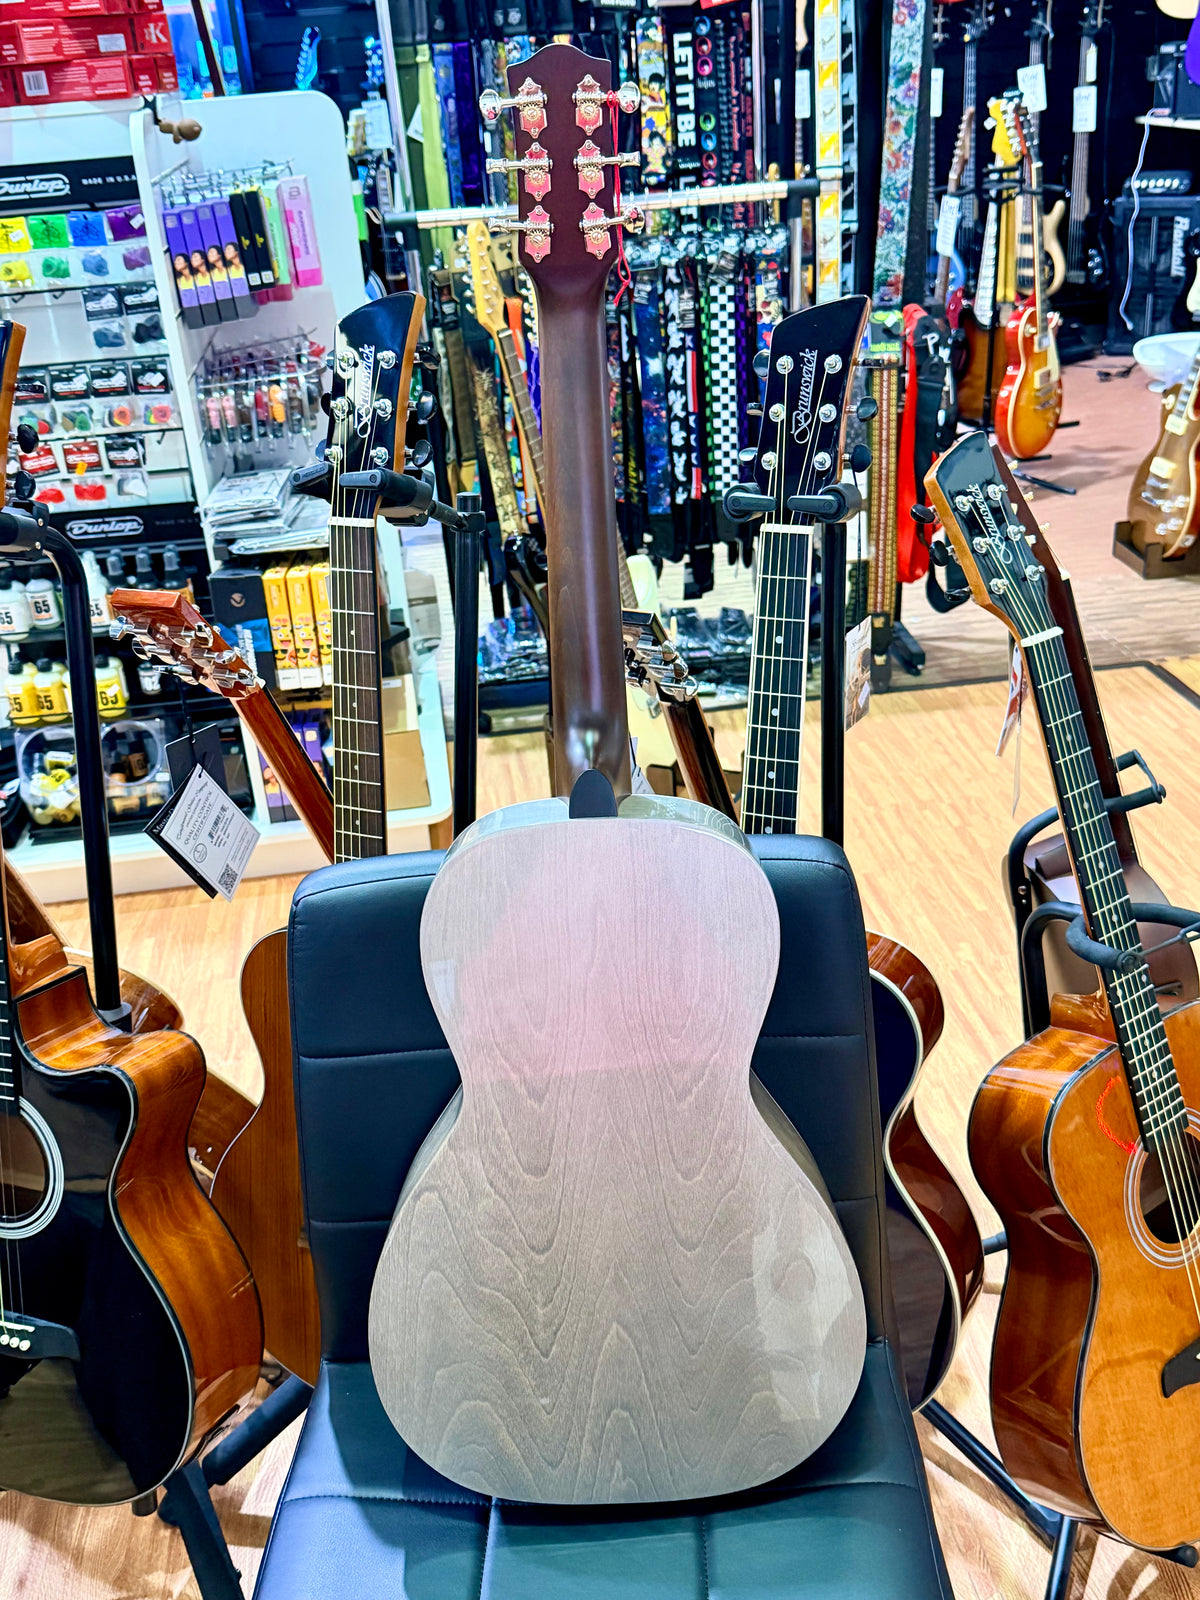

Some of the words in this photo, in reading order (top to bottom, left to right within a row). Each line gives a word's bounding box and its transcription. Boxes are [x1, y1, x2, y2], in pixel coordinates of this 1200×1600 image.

[673, 32, 694, 80] LET
[675, 84, 695, 110] IT
[677, 112, 696, 148] BE
[0, 178, 65, 195] Dunlop
[354, 344, 375, 438] Brunswick
[790, 348, 818, 444] Brunswick
[73, 520, 140, 535] Dunlop
[34, 600, 51, 614] 65
[37, 694, 54, 711] 65
